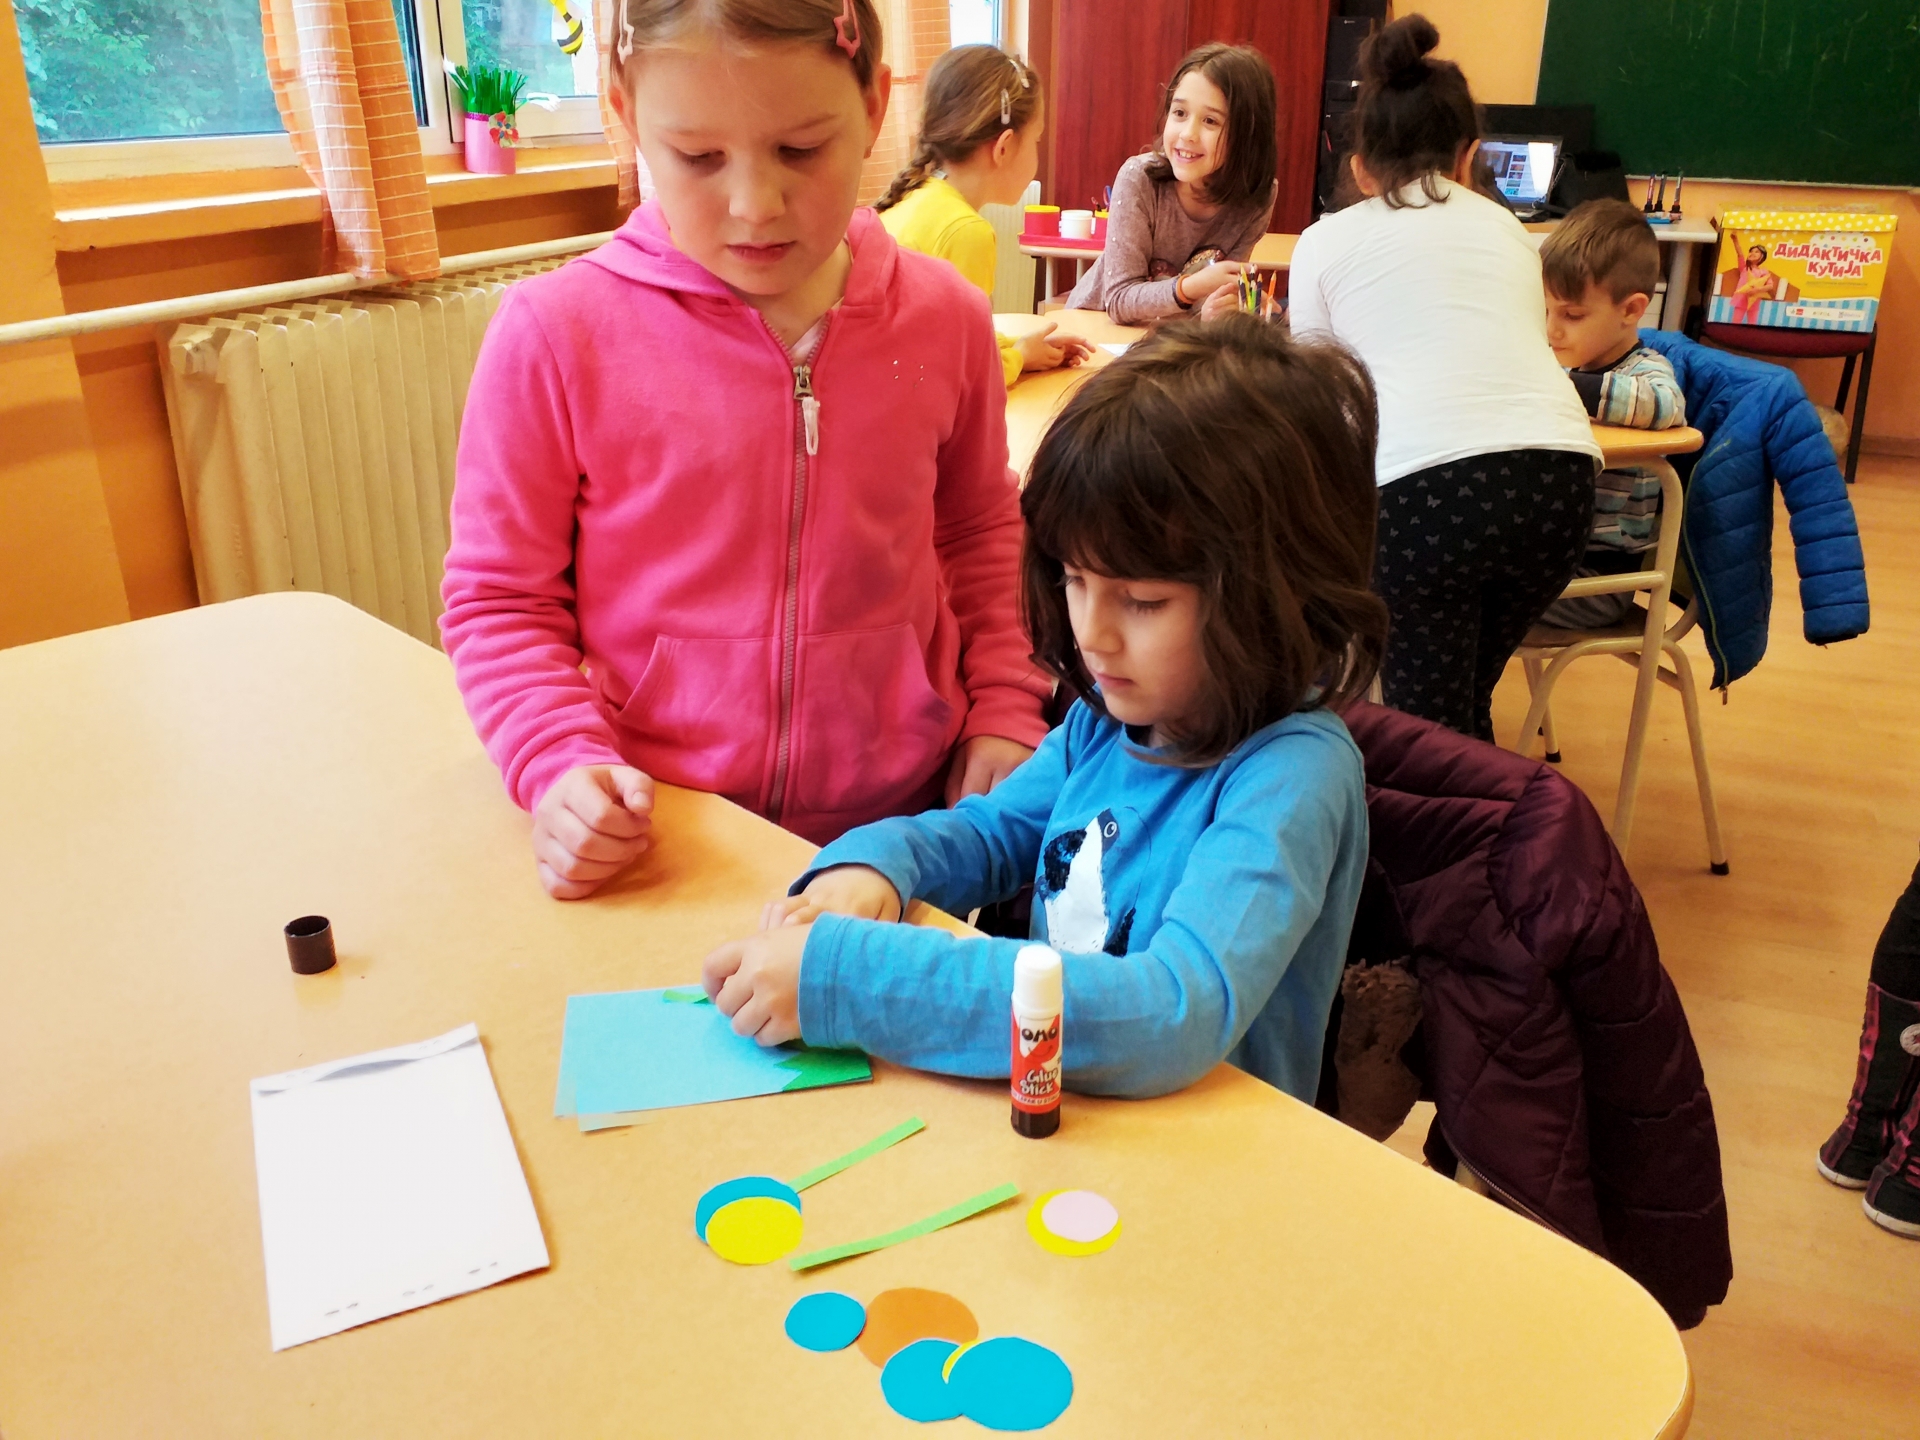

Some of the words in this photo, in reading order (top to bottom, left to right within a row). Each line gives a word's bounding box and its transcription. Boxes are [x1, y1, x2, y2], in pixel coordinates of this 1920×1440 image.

[1774, 243, 1881, 263] ДИДАКТИЧКА
[1807, 260, 1861, 277] КУТИЈА
[1021, 1028, 1058, 1042] OMO
[1026, 1068, 1059, 1083] Glue
[1019, 1079, 1054, 1096] Stick
